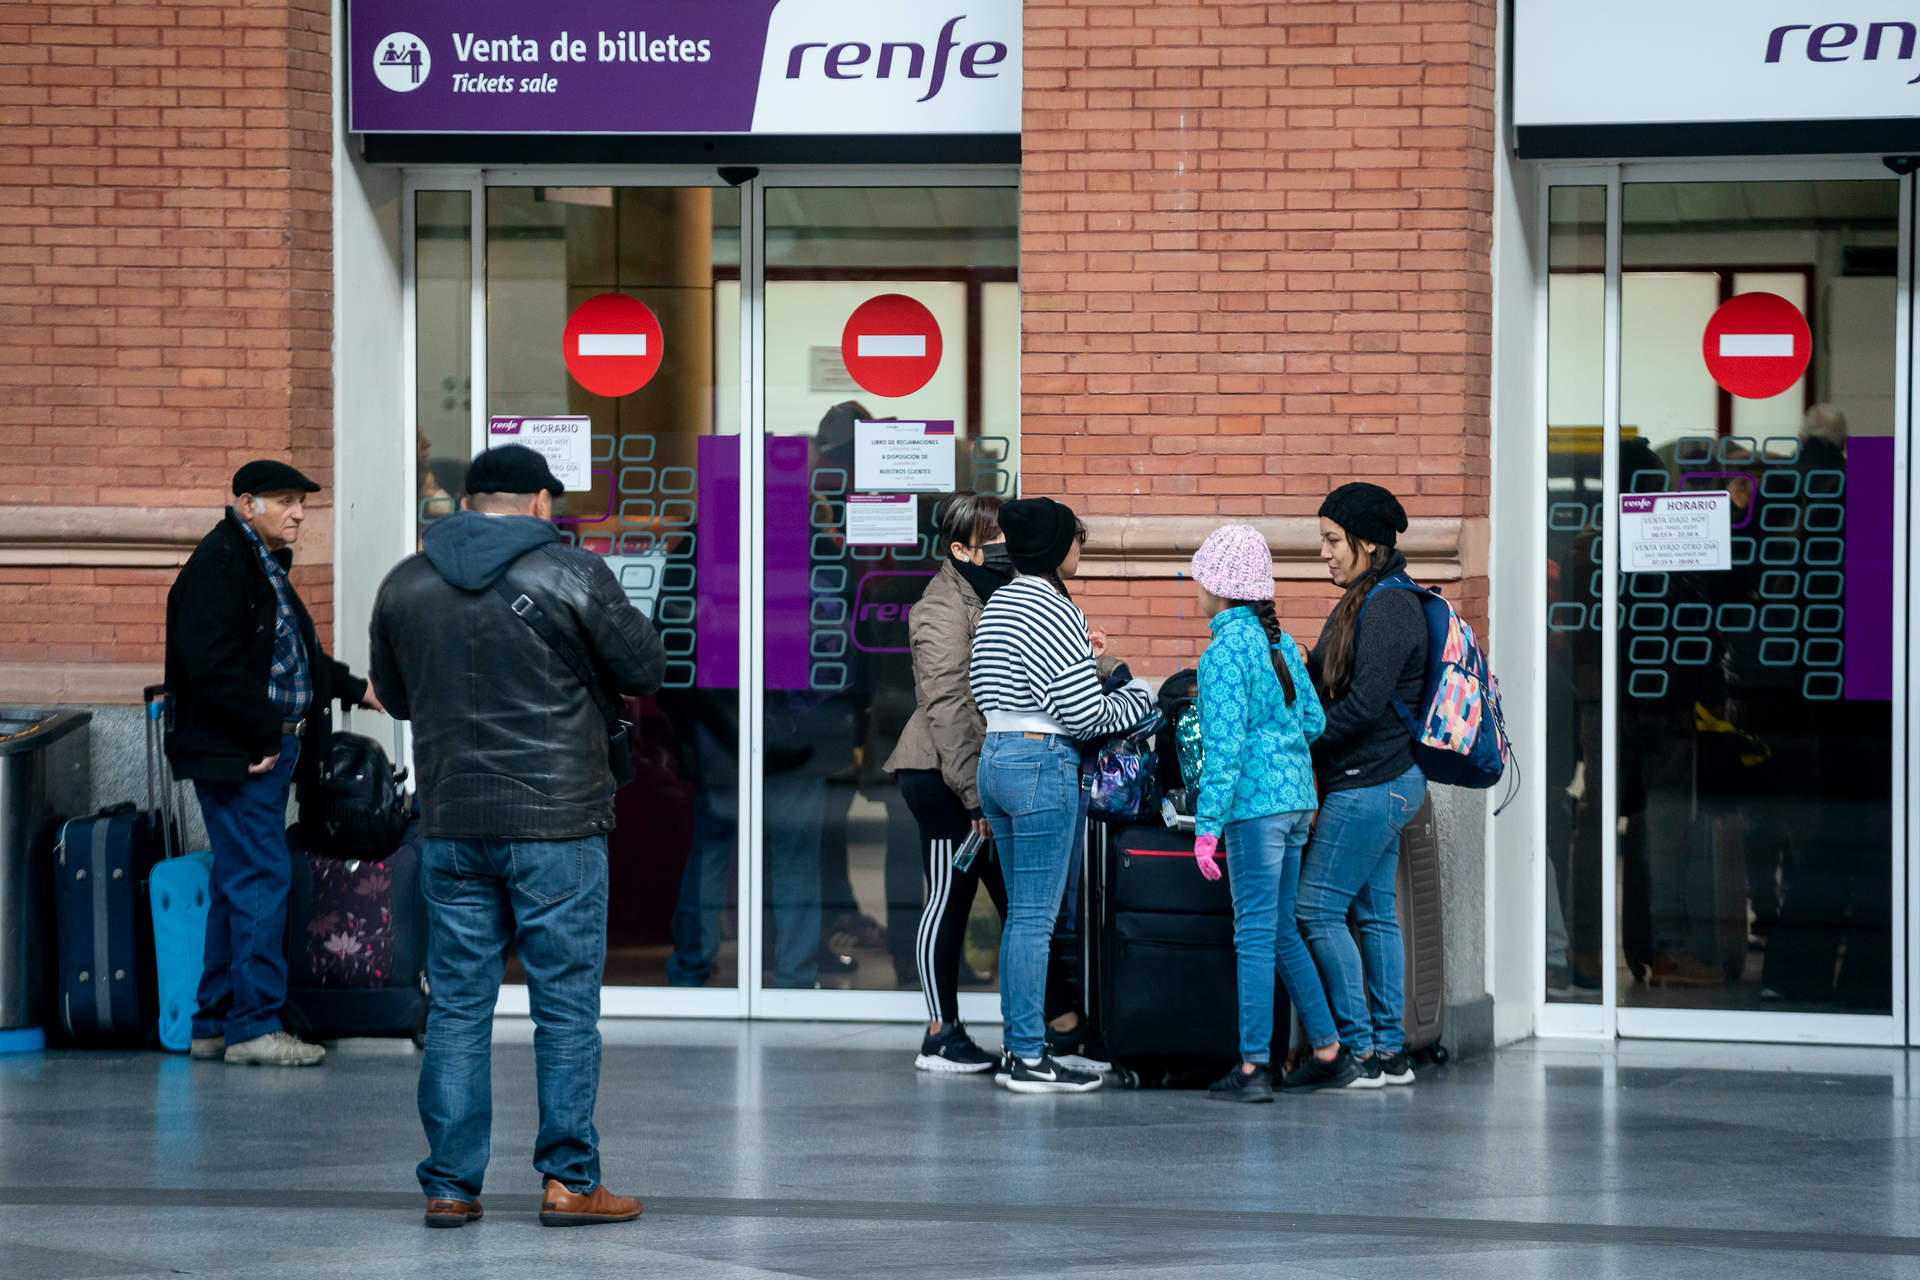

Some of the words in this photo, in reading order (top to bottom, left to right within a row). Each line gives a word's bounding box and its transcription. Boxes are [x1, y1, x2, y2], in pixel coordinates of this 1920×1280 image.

[452, 32, 539, 62] Venta
[550, 31, 586, 62] de
[598, 31, 711, 62] billetes
[786, 15, 1008, 103] renfe
[452, 73, 514, 93] Tickets
[519, 73, 558, 93] sale
[492, 420, 518, 432] renfe
[533, 423, 579, 433] HORARIO
[1667, 500, 1717, 511] HORARIO
